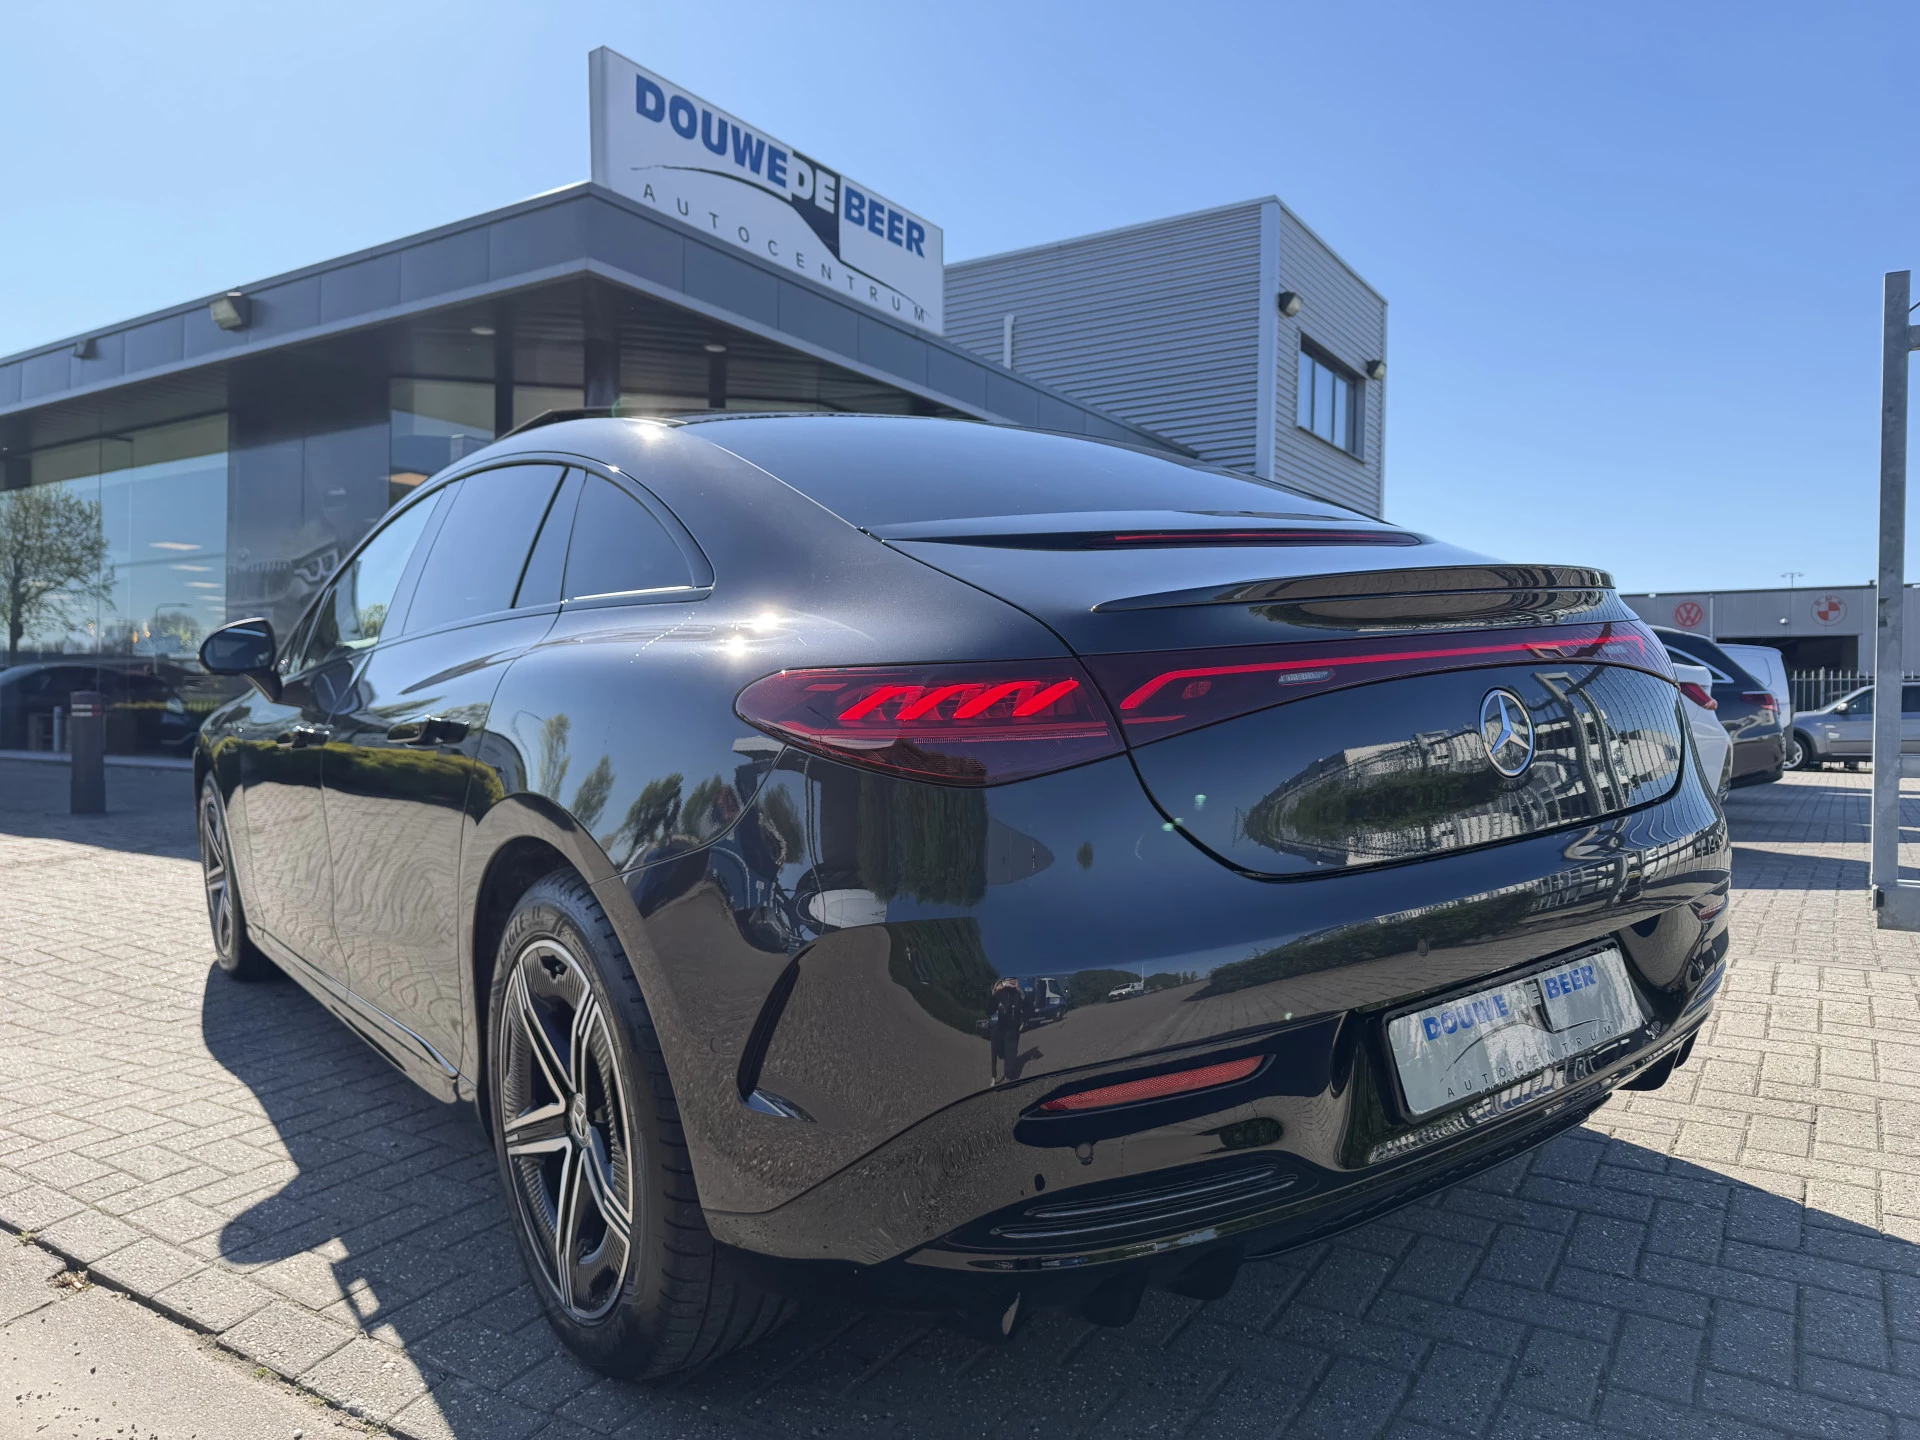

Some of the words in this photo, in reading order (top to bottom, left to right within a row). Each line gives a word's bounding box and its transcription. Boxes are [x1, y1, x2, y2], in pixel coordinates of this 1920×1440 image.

[635, 72, 788, 188] DOUWE
[788, 154, 836, 214] DE
[844, 185, 925, 258] BEER
[643, 183, 925, 323] AUTOCENTRUM
[1423, 995, 1509, 1041] DOUWE
[1543, 964, 1597, 1000] BEER
[1447, 1025, 1612, 1097] AUTOCENTRUM
